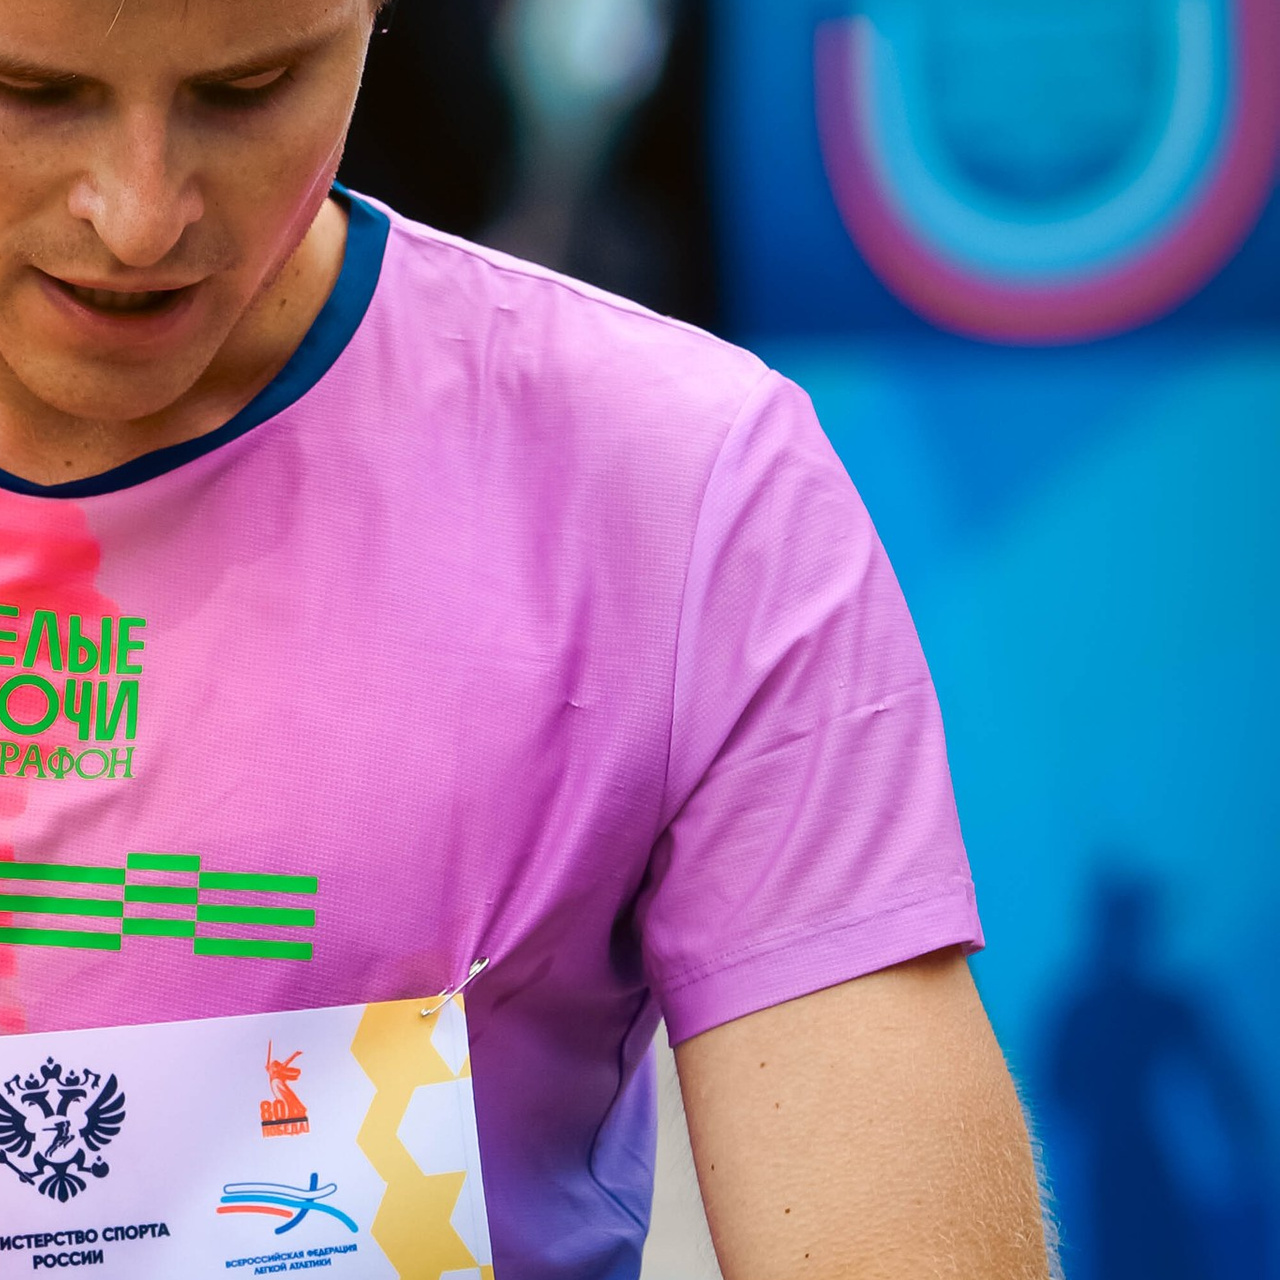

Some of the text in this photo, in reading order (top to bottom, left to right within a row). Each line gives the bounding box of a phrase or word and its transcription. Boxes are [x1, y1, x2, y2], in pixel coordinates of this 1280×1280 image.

[102, 1223, 170, 1242] СПОРТА
[32, 1250, 104, 1270] РОССИИ
[225, 1243, 358, 1268] ВСЕРОССИЙСКАЯ ФЕДЕРАЦИЯ
[289, 1258, 332, 1271] АТЛЕТИКИ
